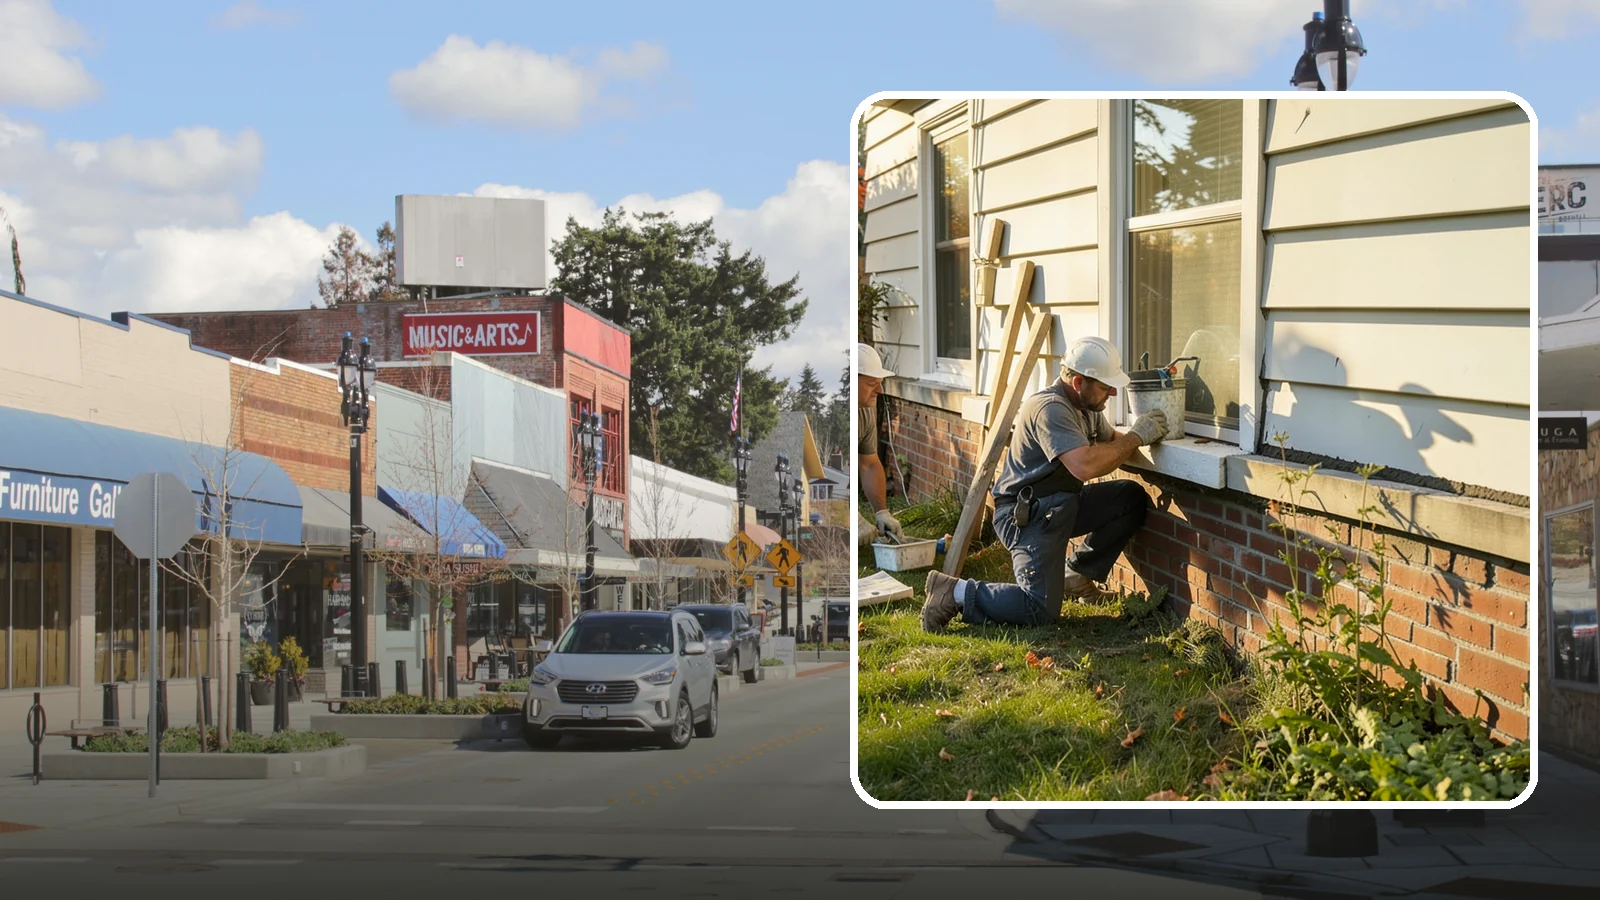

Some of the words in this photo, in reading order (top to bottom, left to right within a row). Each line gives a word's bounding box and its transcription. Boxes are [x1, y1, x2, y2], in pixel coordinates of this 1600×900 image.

[1540, 427, 1578, 437] UGA
[0, 471, 79, 515] Furniture
[89, 482, 121, 519] Gal
[453, 563, 479, 574] SUSHI
